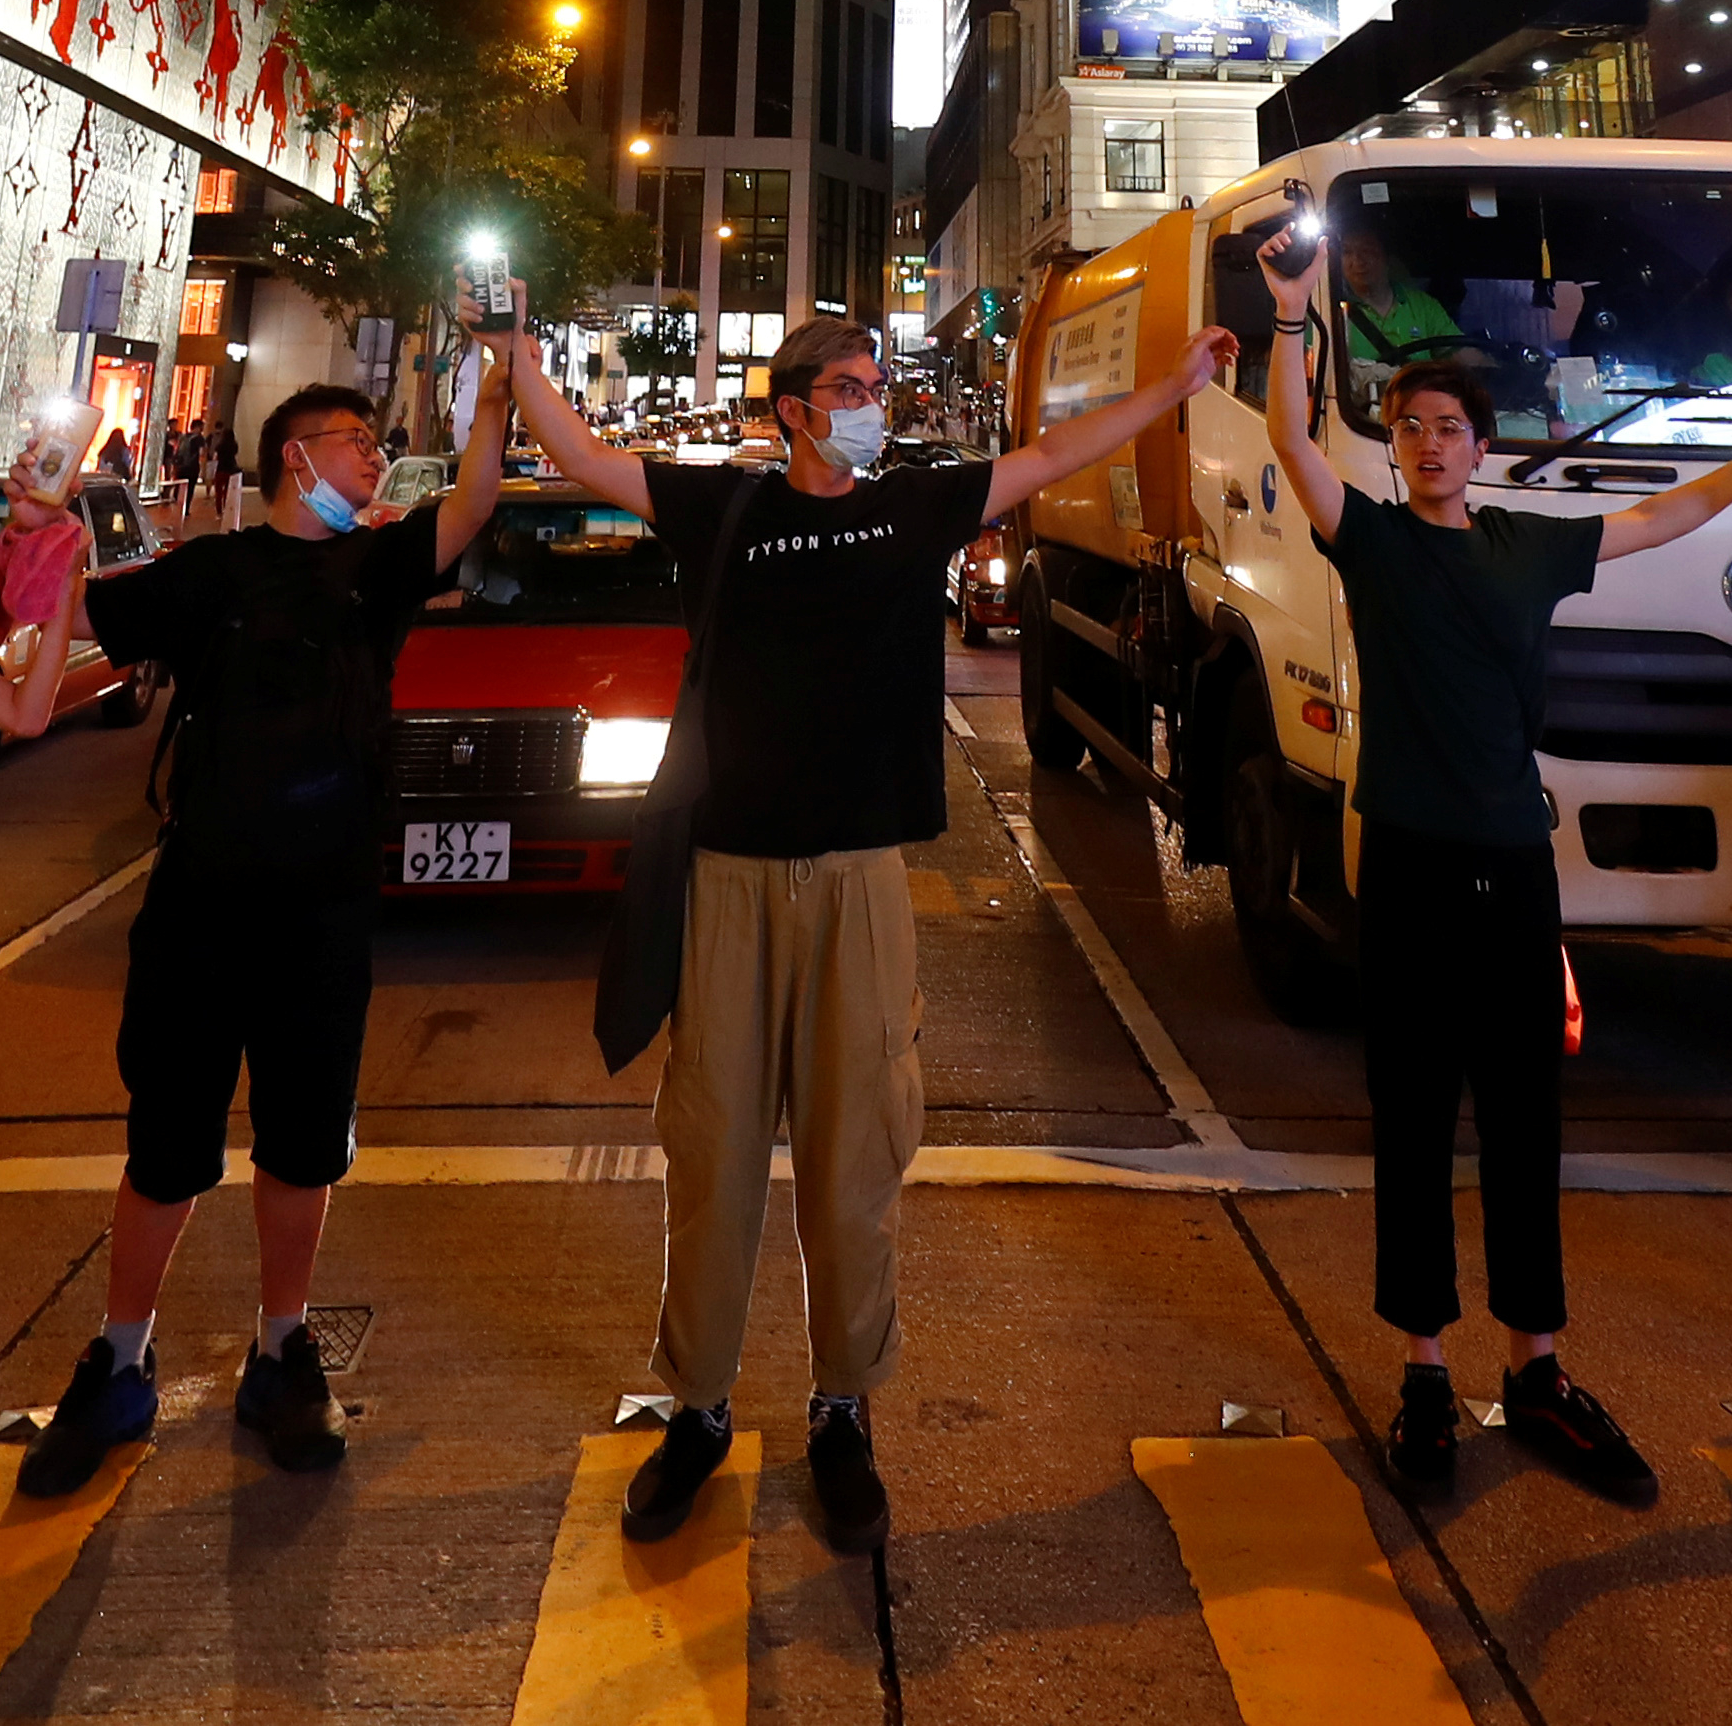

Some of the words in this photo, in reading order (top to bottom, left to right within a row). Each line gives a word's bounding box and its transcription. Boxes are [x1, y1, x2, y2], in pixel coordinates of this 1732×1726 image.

[1089, 67, 1126, 81] Asiaray
[473, 266, 487, 285] NOT
[747, 535, 819, 562] TYSON
[832, 524, 894, 546] YOSHI
[435, 823, 480, 852] KY
[410, 851, 503, 881] 9227
